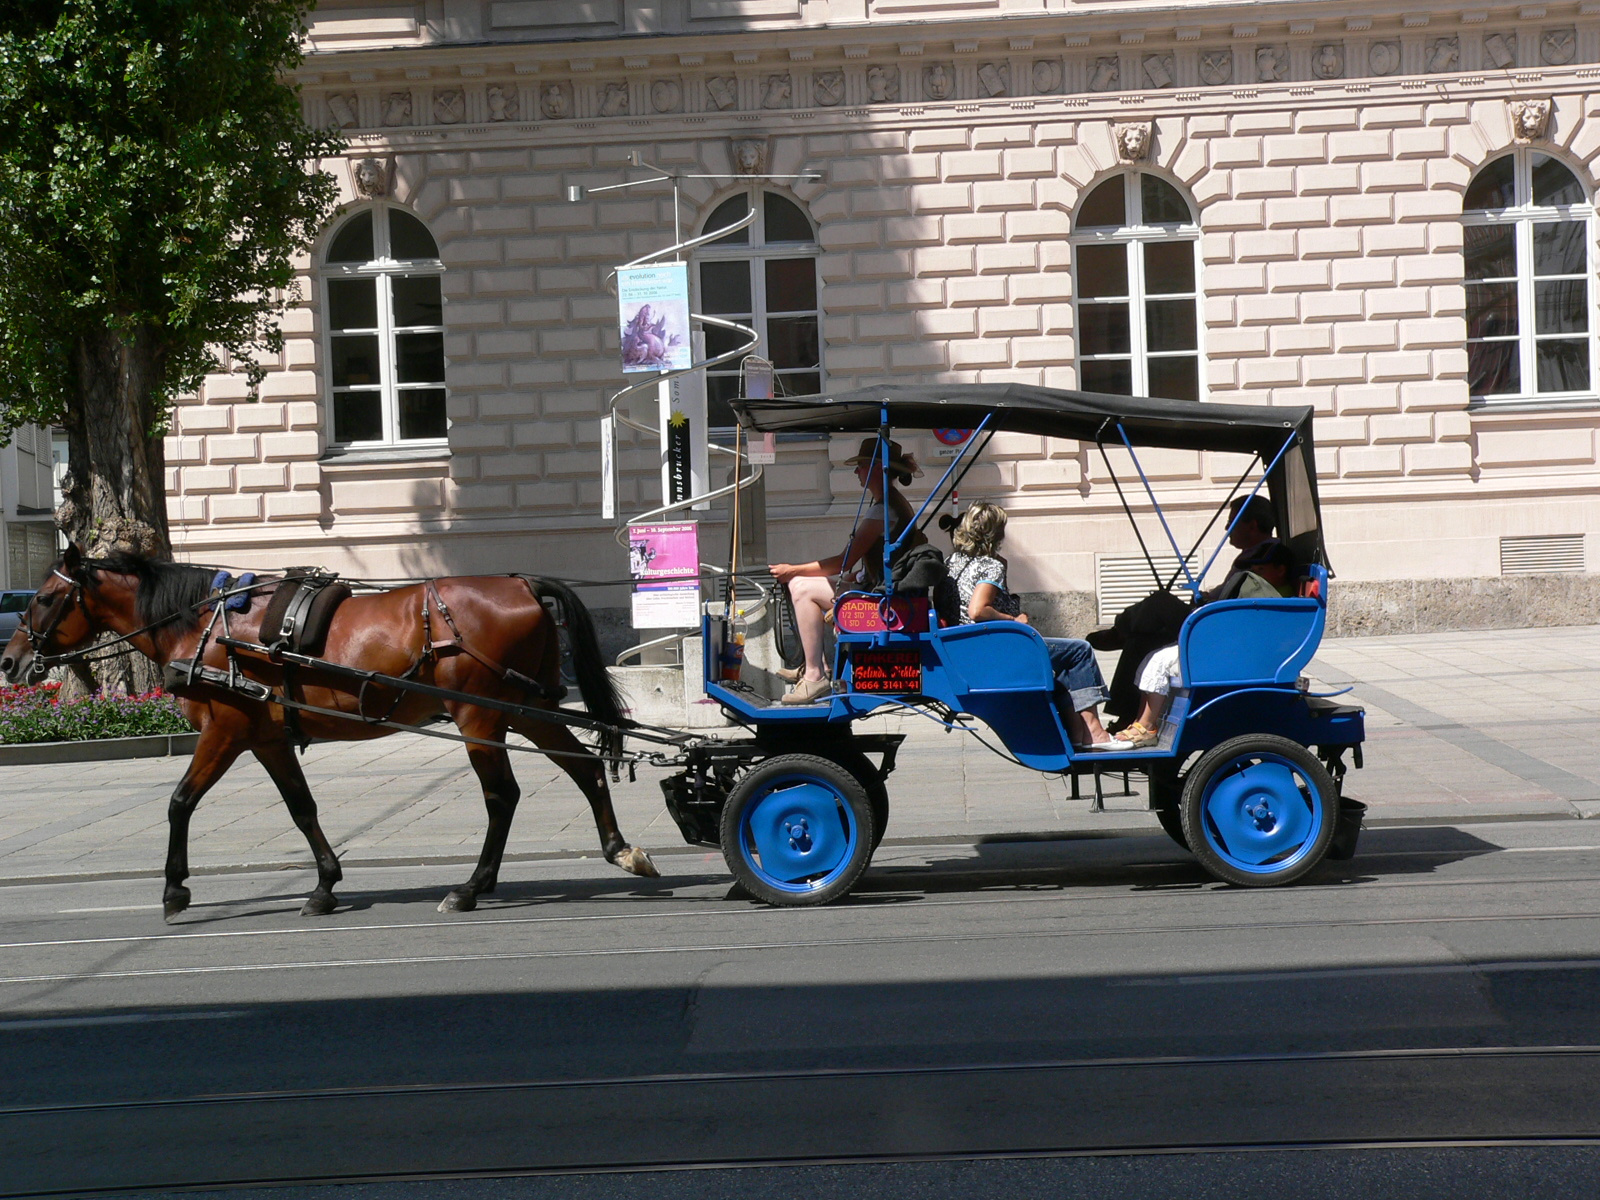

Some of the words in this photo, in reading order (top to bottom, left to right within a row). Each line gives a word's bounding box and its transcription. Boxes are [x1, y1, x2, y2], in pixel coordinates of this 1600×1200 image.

[672, 376, 681, 404] Som
[673, 435, 683, 504] nnsbrucker
[637, 527, 647, 535] Juni
[658, 526, 682, 534] September
[639, 568, 694, 577] Kulturgeschichte
[842, 602, 879, 611] STADTRU
[842, 611, 851, 619] 1/2
[854, 611, 865, 619] STD
[849, 619, 860, 627] STD
[866, 619, 876, 627] 50
[855, 653, 919, 664] FIAKEREI
[855, 680, 880, 690] 0664
